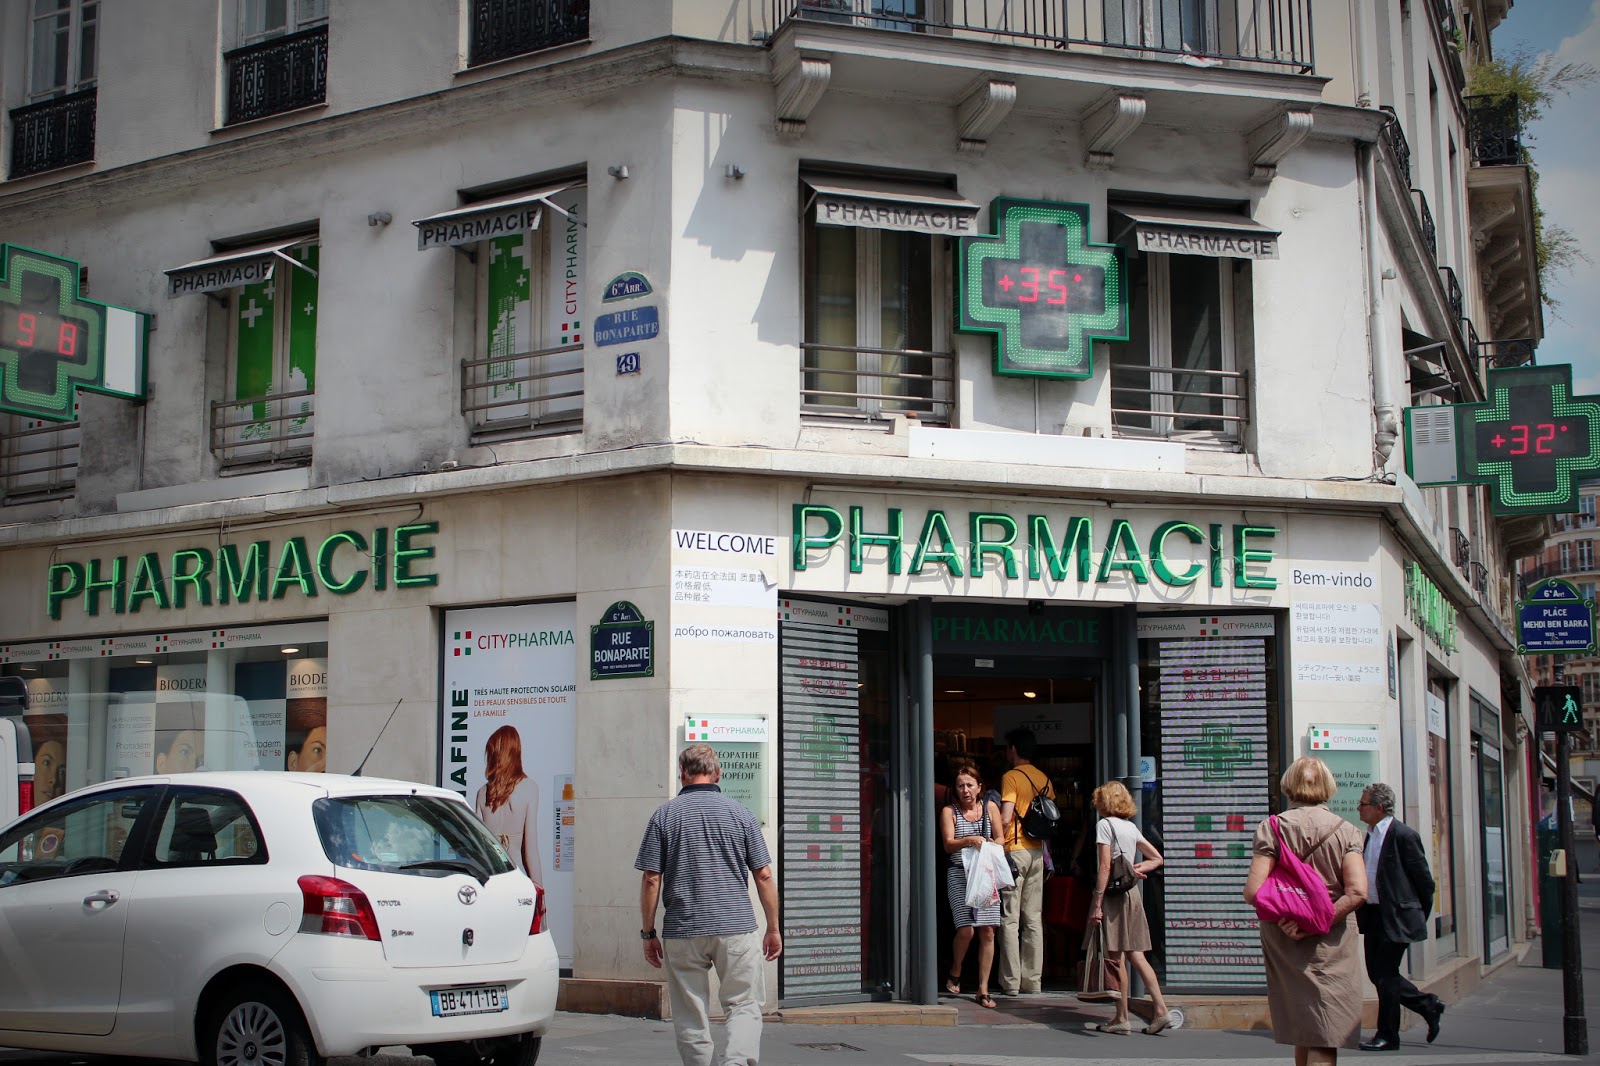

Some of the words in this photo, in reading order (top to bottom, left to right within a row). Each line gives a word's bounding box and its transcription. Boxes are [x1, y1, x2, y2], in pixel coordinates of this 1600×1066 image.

[826, 202, 969, 230] PHARMACIE
[423, 211, 537, 245] PHARMACIE
[1144, 231, 1273, 255] PHARMACIE
[565, 203, 577, 315] CITYPHARMA
[173, 261, 271, 293] PHARMACIE
[614, 310, 638, 324] RUE
[595, 322, 658, 342] BONAPARTE
[618, 354, 637, 373] 49
[676, 531, 775, 555] WELCOME
[793, 503, 1281, 589] PHARMACIE
[47, 521, 439, 620] PHARMACIE
[1293, 569, 1372, 588] Bem-vindo
[792, 607, 829, 618] CITYPHARMA
[1543, 608, 1568, 617] PLACE
[932, 616, 1099, 644] PHARMACIE
[1222, 622, 1273, 630] CITYPHARMA
[1523, 621, 1546, 629] MEHDI
[1547, 620, 1562, 628] BEN
[1563, 619, 1589, 628] BARKA
[227, 633, 262, 642] CITYPHARMA
[477, 630, 575, 650] CITYPHARMA
[612, 631, 632, 645] RUE
[675, 626, 709, 641] добро
[711, 628, 775, 640] пожаловать
[170, 638, 203, 647] CITYPHARMA
[594, 647, 650, 663] BONAPARTE
[474, 686, 488, 696] TRÈS
[489, 687, 509, 695] HAUTE
[510, 685, 549, 695] PROTECTION
[550, 684, 576, 693] SOLAIRE
[506, 698, 537, 706] SENSIBLES
[1333, 735, 1377, 744] CITYPHARMA
[716, 750, 760, 759] ÉOPATHIE
